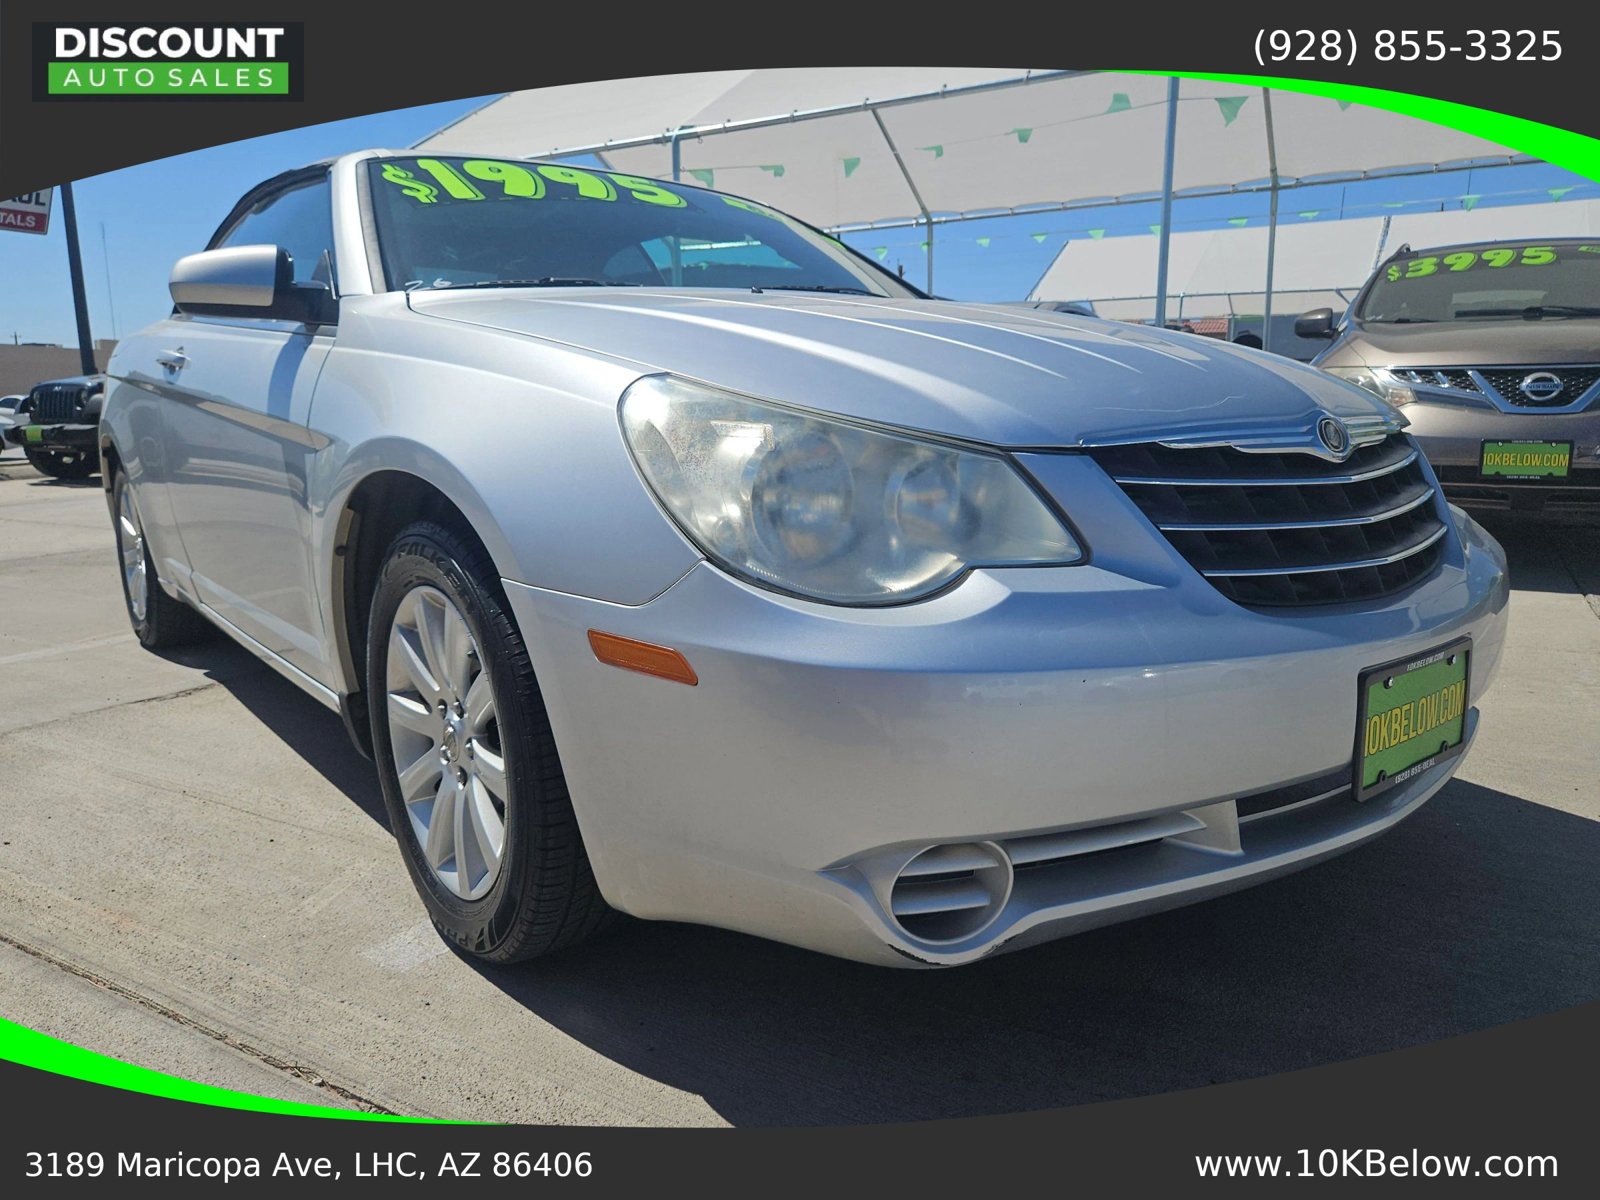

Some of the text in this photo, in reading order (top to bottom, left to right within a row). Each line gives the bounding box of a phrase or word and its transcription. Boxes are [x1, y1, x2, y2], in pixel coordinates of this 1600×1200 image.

[381, 158, 688, 209] $1995
[1387, 246, 1557, 282] $3995
[1483, 453, 1570, 468] 10KBELOW.COM
[1364, 680, 1466, 756] 10KBELOW.COM
